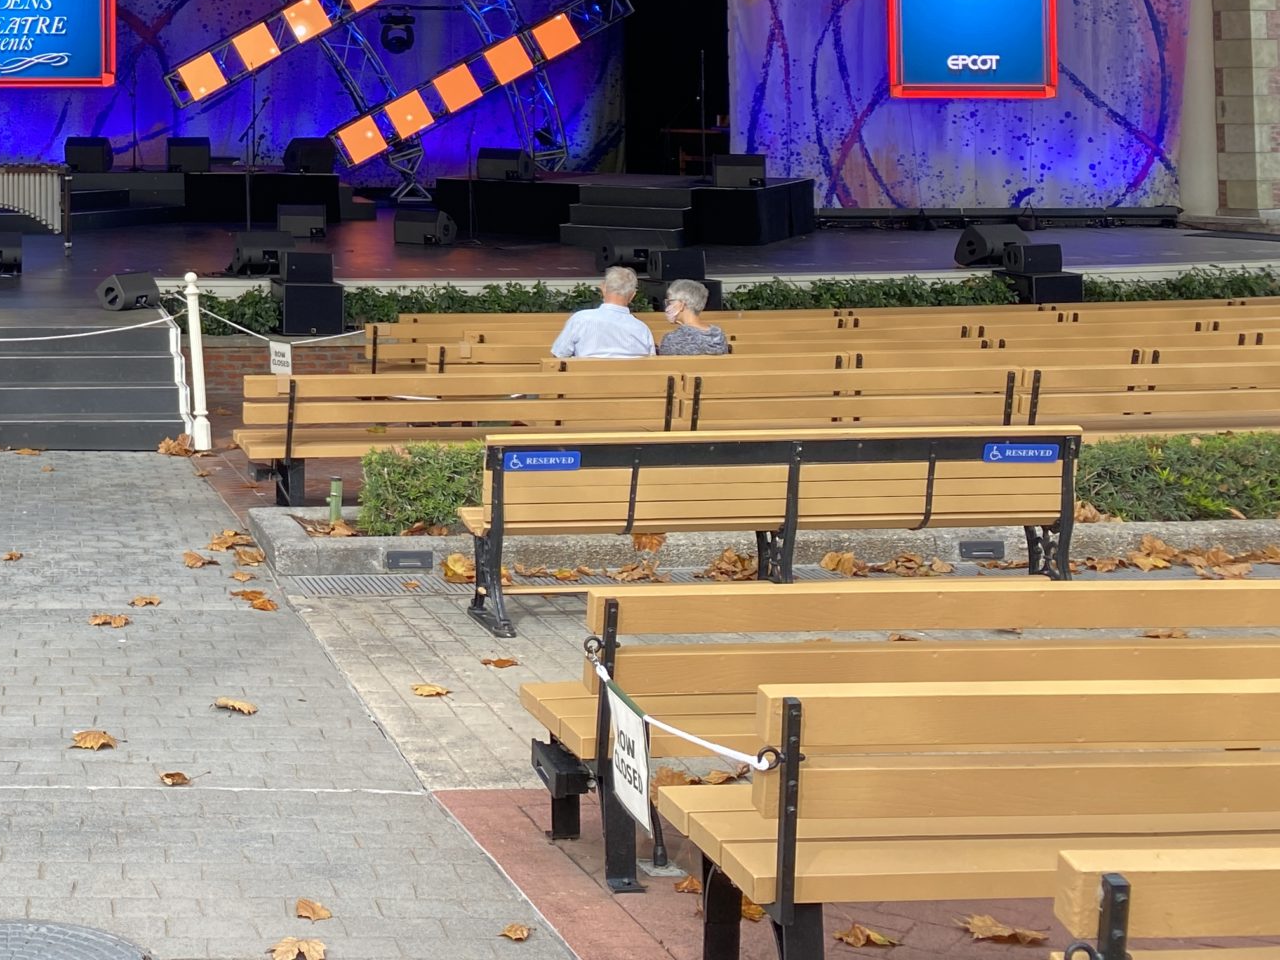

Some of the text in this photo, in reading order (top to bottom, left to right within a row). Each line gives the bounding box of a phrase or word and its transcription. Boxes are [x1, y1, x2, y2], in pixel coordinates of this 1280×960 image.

[946, 55, 1000, 70] EPCOT
[272, 358, 290, 367] CLOSED
[1005, 449, 1053, 457] RESERVED
[526, 457, 575, 465] RESERVED
[618, 730, 635, 759] OW
